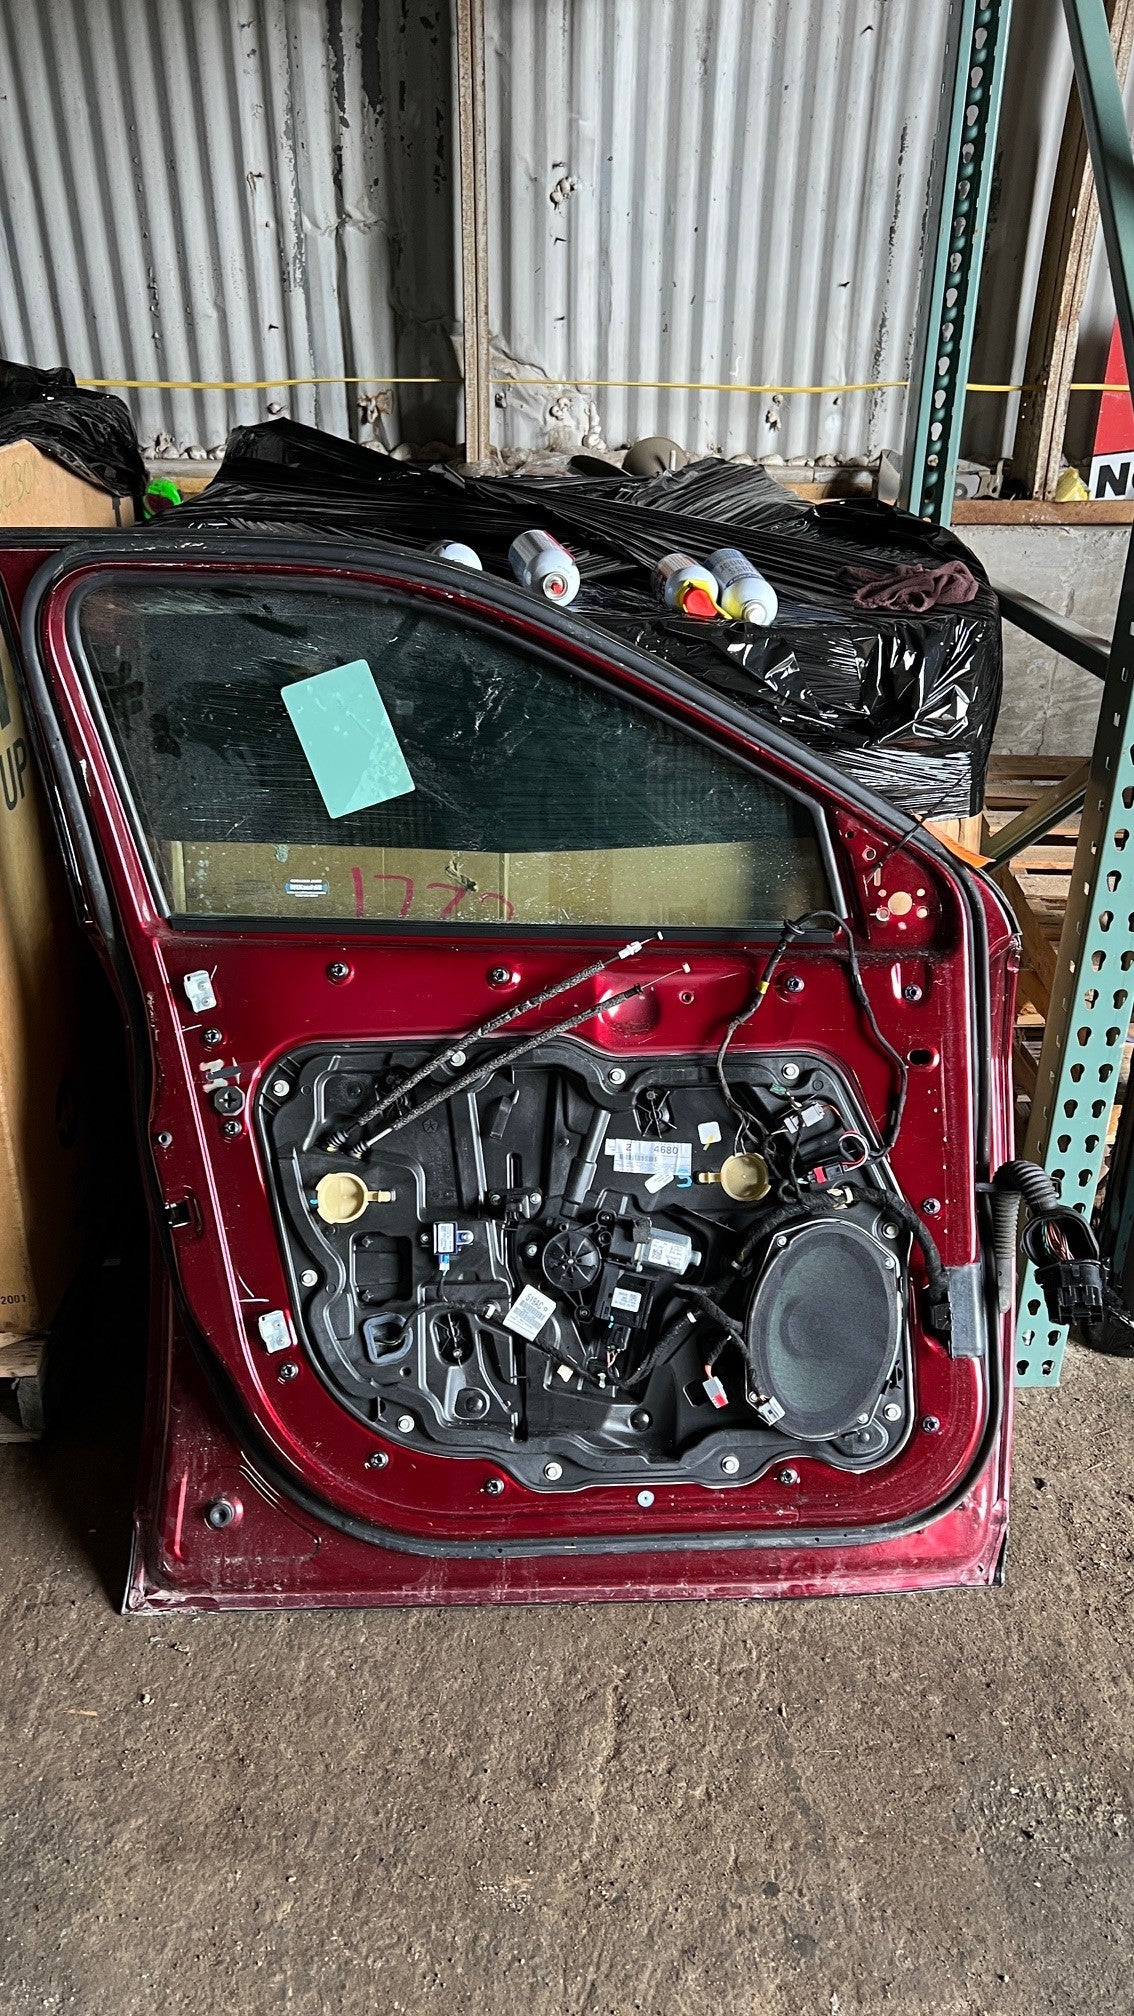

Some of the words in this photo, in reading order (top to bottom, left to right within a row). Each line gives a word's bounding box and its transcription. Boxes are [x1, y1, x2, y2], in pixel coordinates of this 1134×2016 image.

[1095, 461, 1134, 498] N
[0, 737, 27, 811] UP
[653, 1145, 679, 1155] 4680
[0, 1294, 26, 1305] 2001
